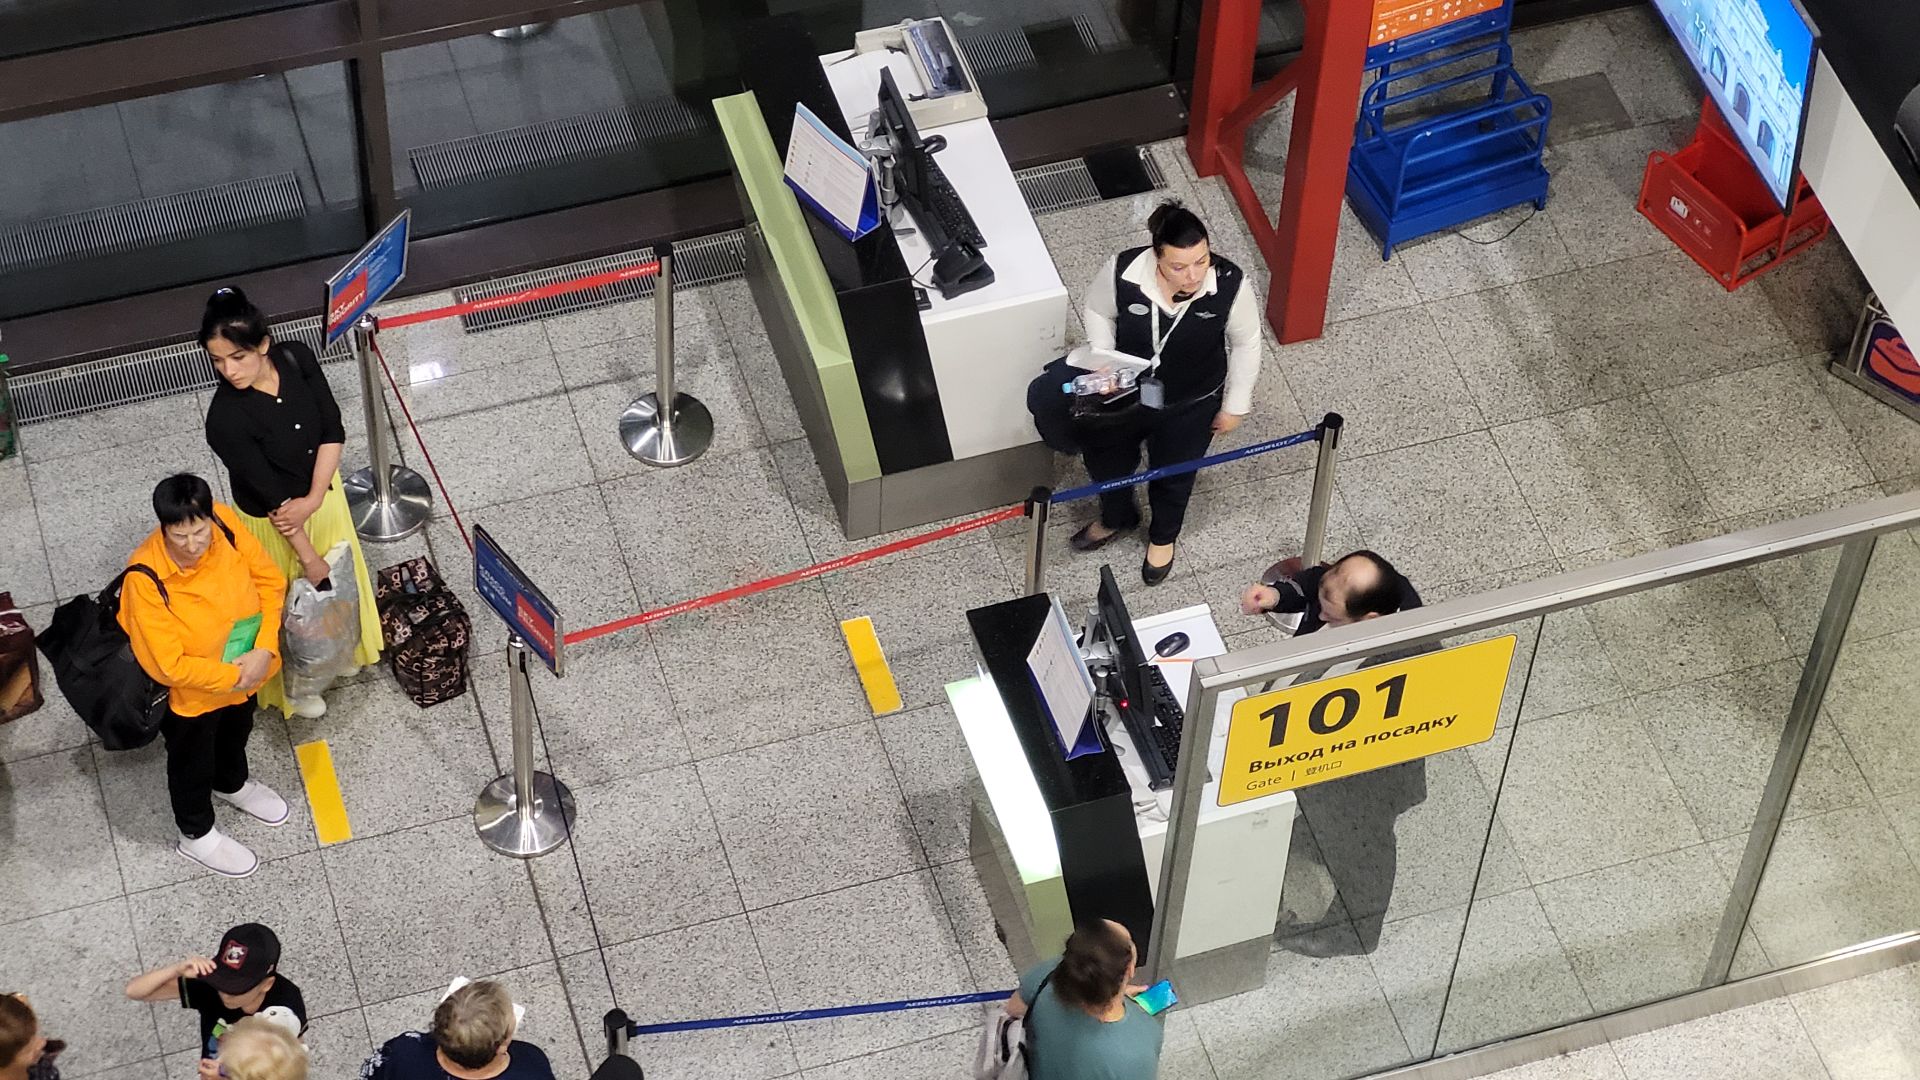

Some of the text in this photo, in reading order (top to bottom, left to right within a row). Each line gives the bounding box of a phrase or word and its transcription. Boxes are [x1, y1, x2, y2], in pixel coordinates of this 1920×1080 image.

[473, 295, 518, 309] AEROFLOT
[1244, 440, 1289, 455] AEROFLOT
[1101, 475, 1145, 490] AEROFLOT
[954, 516, 999, 532] AEROFLOT
[800, 560, 845, 576] AEROFLOT
[642, 605, 688, 621] AEROFLOT
[1259, 673, 1408, 748] 101
[1249, 714, 1458, 774] Выход на посадку
[1304, 760, 1342, 776] 登机口
[1246, 776, 1282, 791] Gate
[905, 998, 957, 1008] AEROFLOT
[732, 1015, 786, 1024] AEROFLOT
